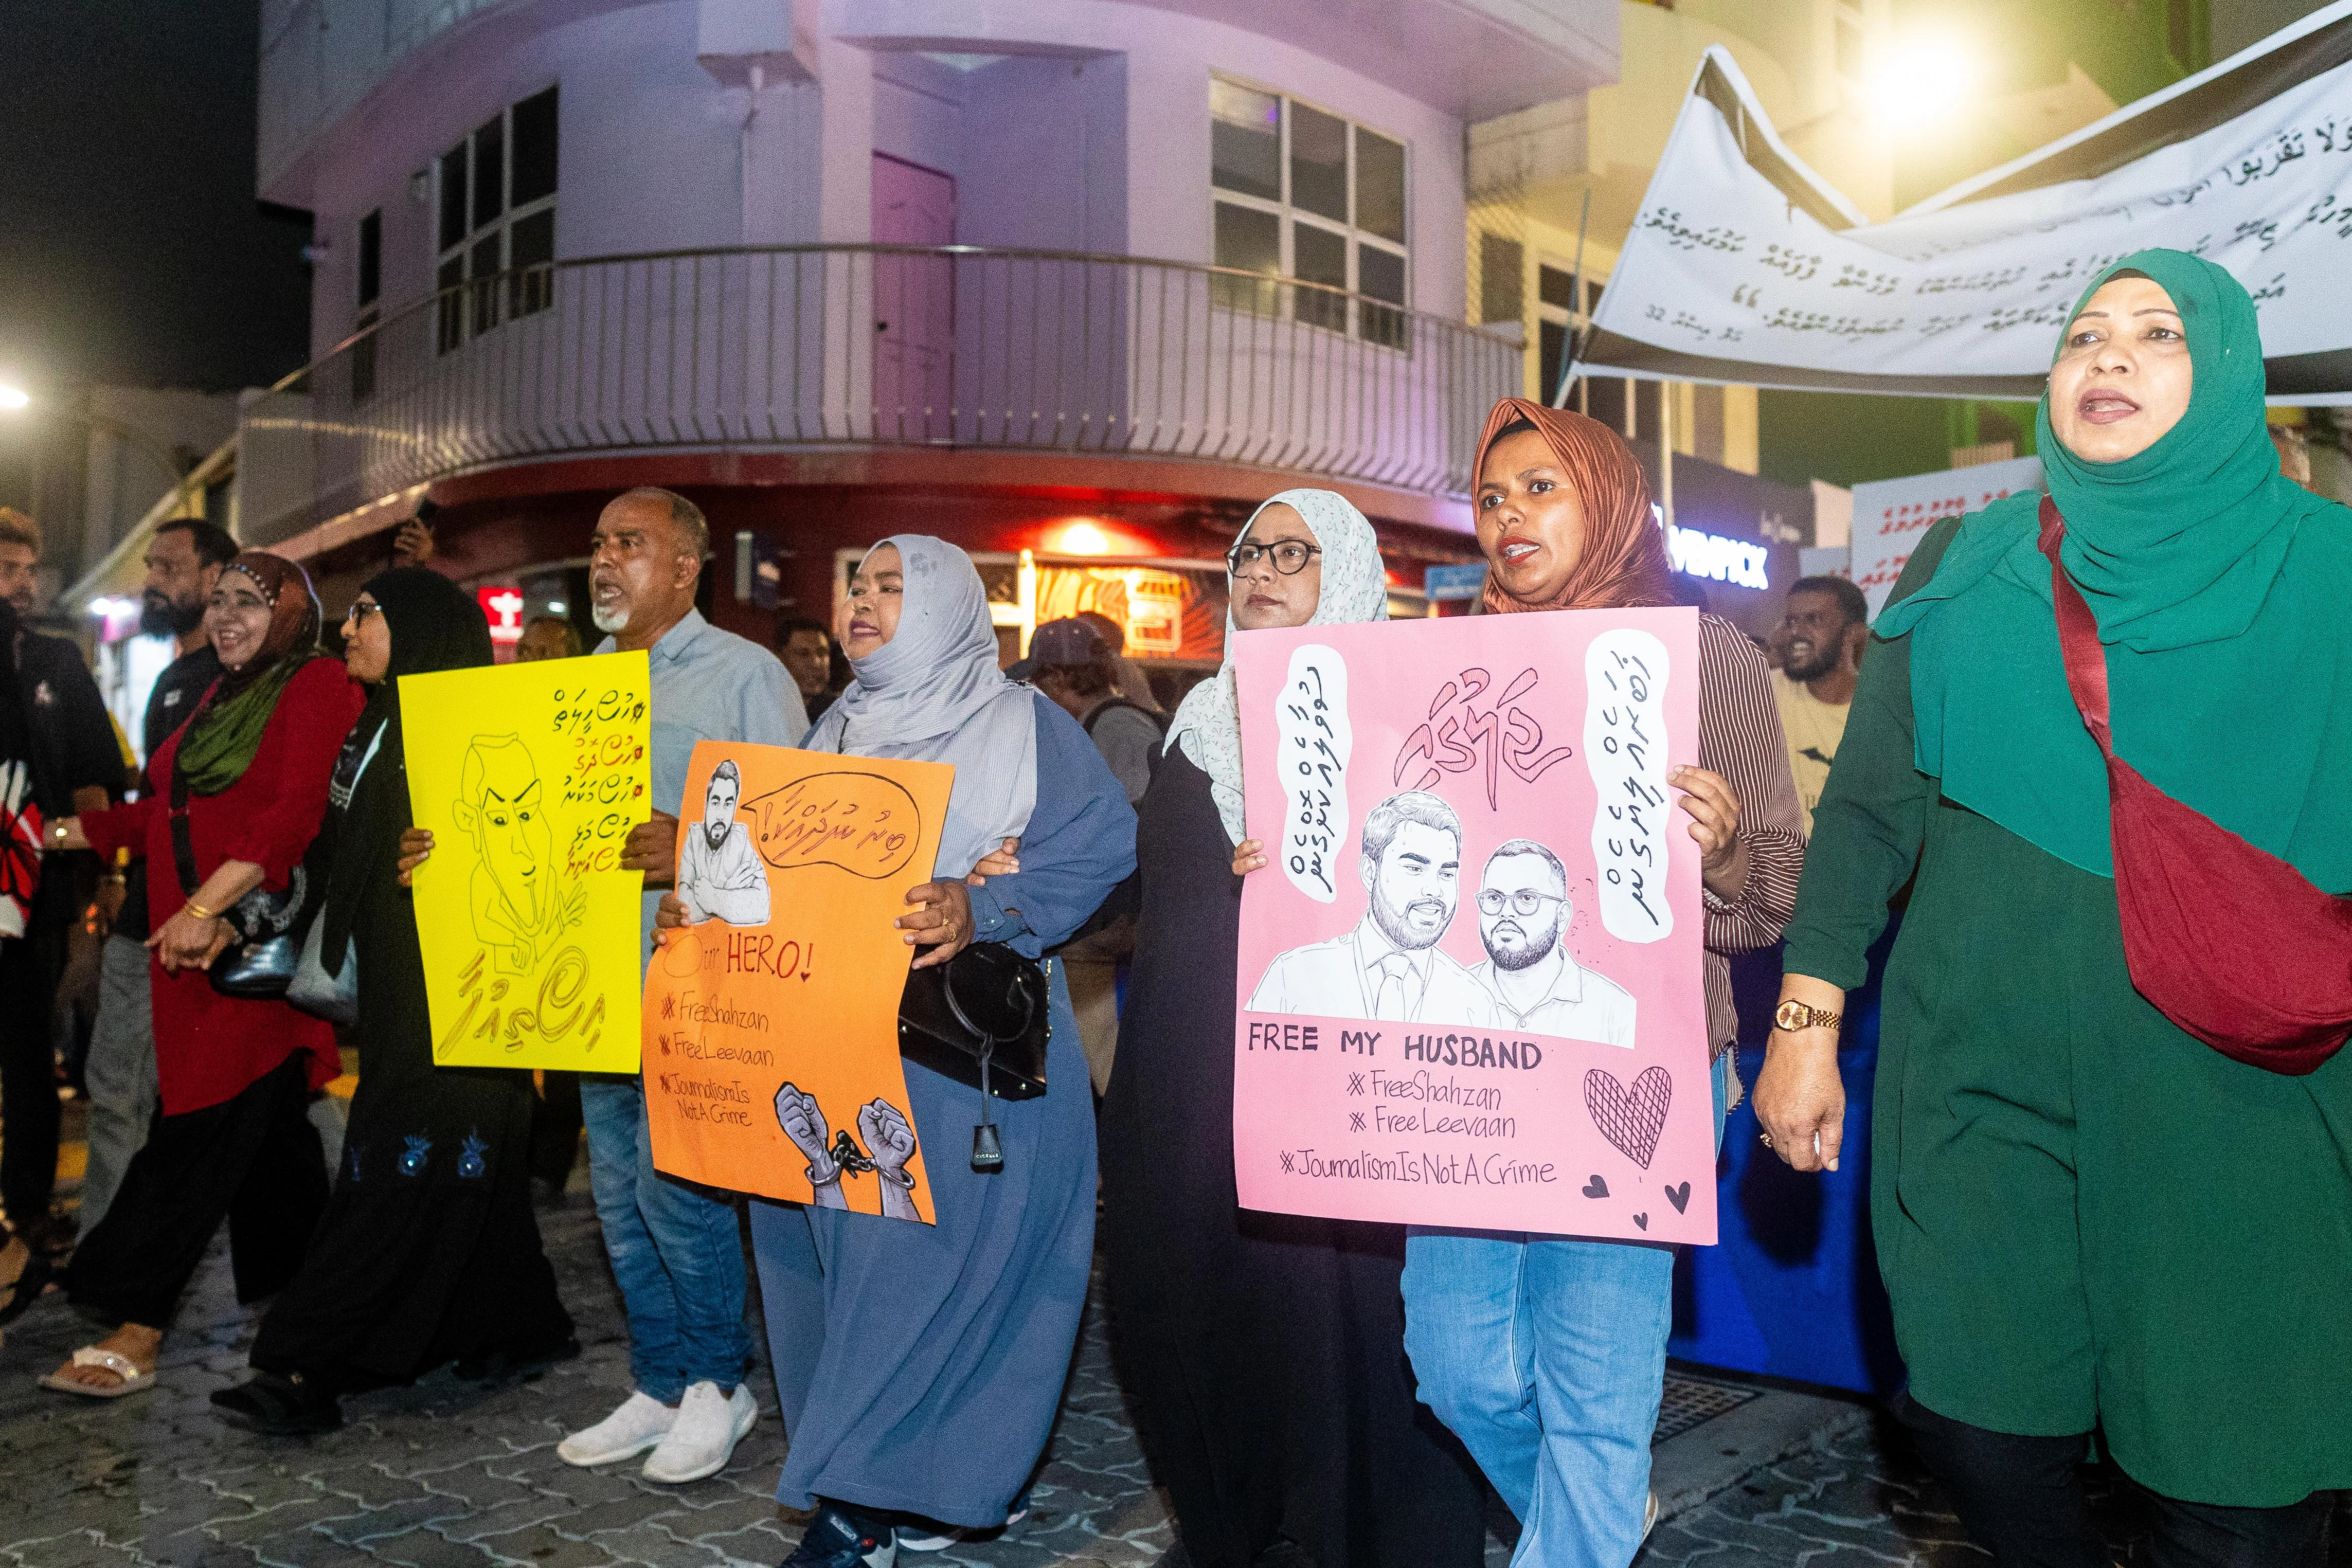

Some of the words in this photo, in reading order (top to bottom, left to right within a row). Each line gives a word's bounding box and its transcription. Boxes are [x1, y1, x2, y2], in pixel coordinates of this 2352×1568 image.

[726, 932, 814, 983] HERO!
[1249, 1022, 1318, 1051] FREE
[1341, 1030, 1382, 1057] MY
[1404, 1034, 1542, 1071] HUSBAND
